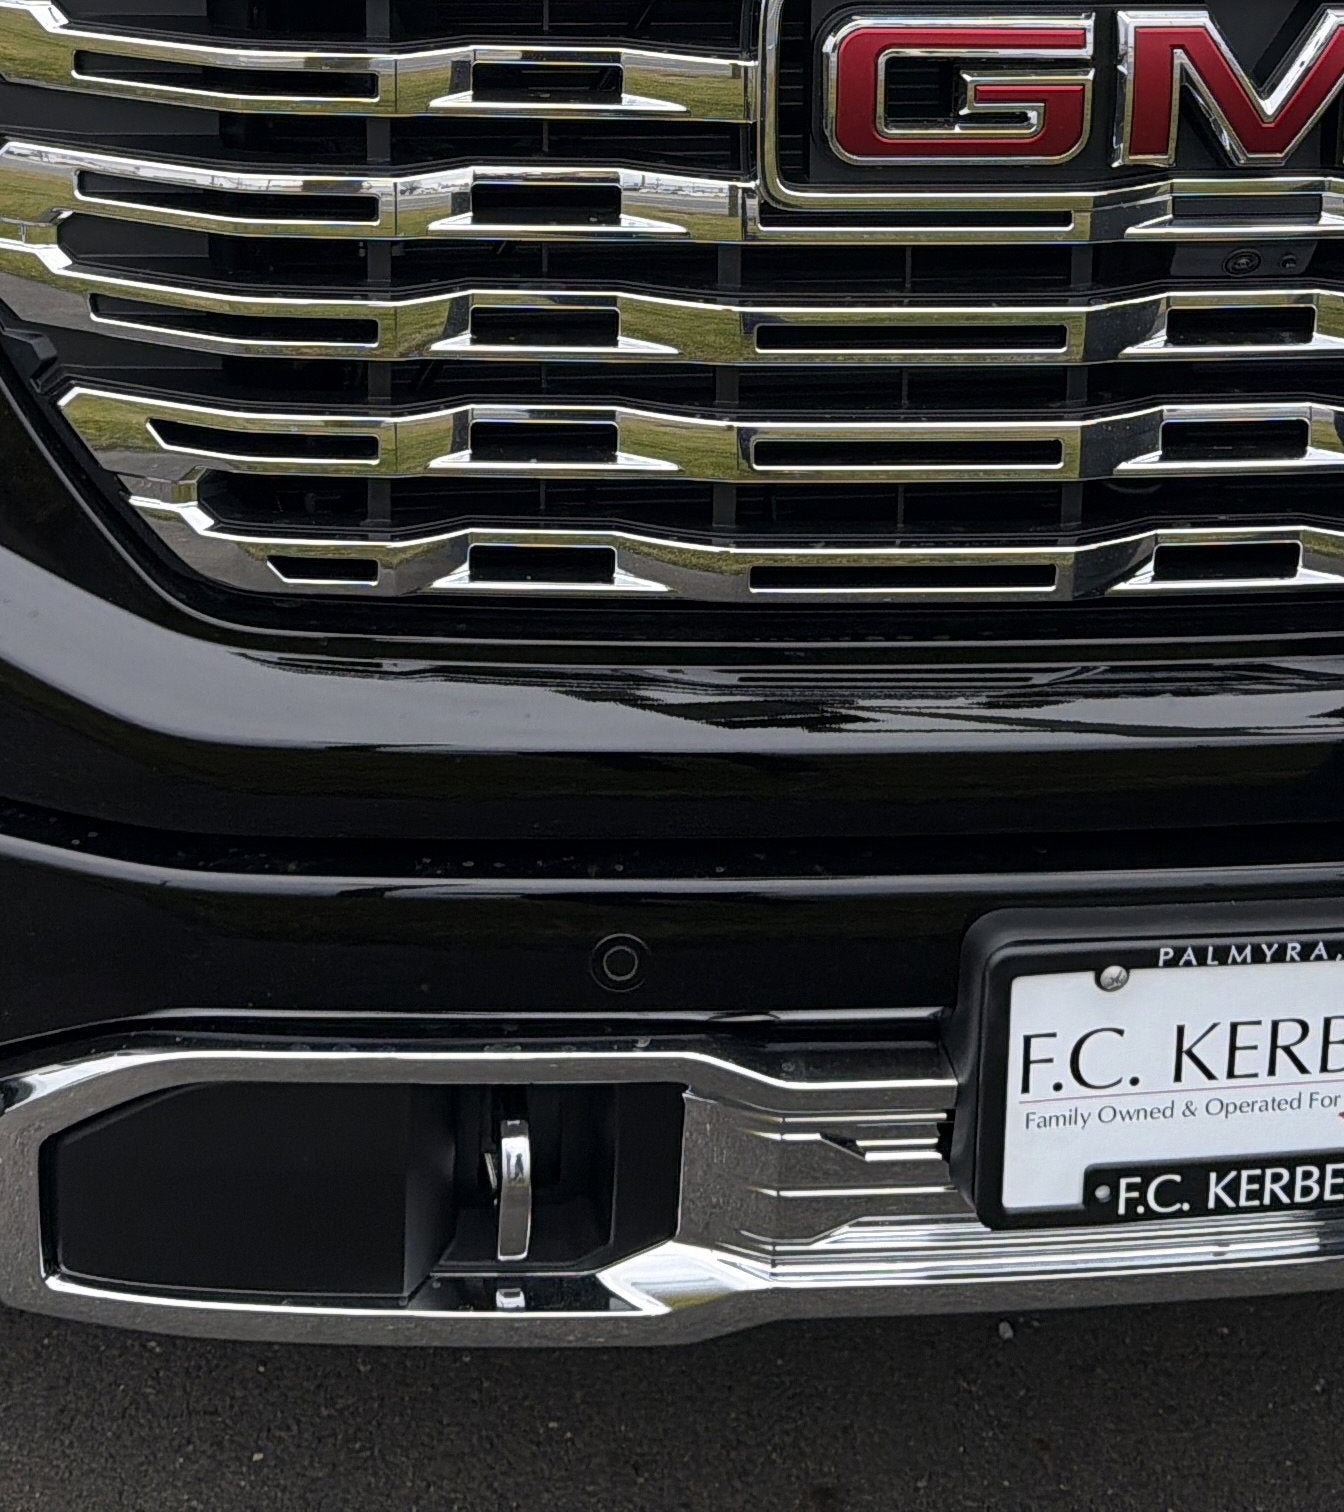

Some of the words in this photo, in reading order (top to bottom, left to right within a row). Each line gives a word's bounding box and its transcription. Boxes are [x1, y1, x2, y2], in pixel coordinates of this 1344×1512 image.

[1159, 941, 1343, 967] PALMYRA,
[1020, 1026, 1141, 1094] F.C.
[1025, 1108, 1091, 1131] Family
[1097, 1100, 1175, 1125] Owned
[1181, 1100, 1199, 1119] &
[1205, 1092, 1303, 1120] Operated
[1308, 1090, 1342, 1109] For
[1117, 1175, 1191, 1215] F.C.
